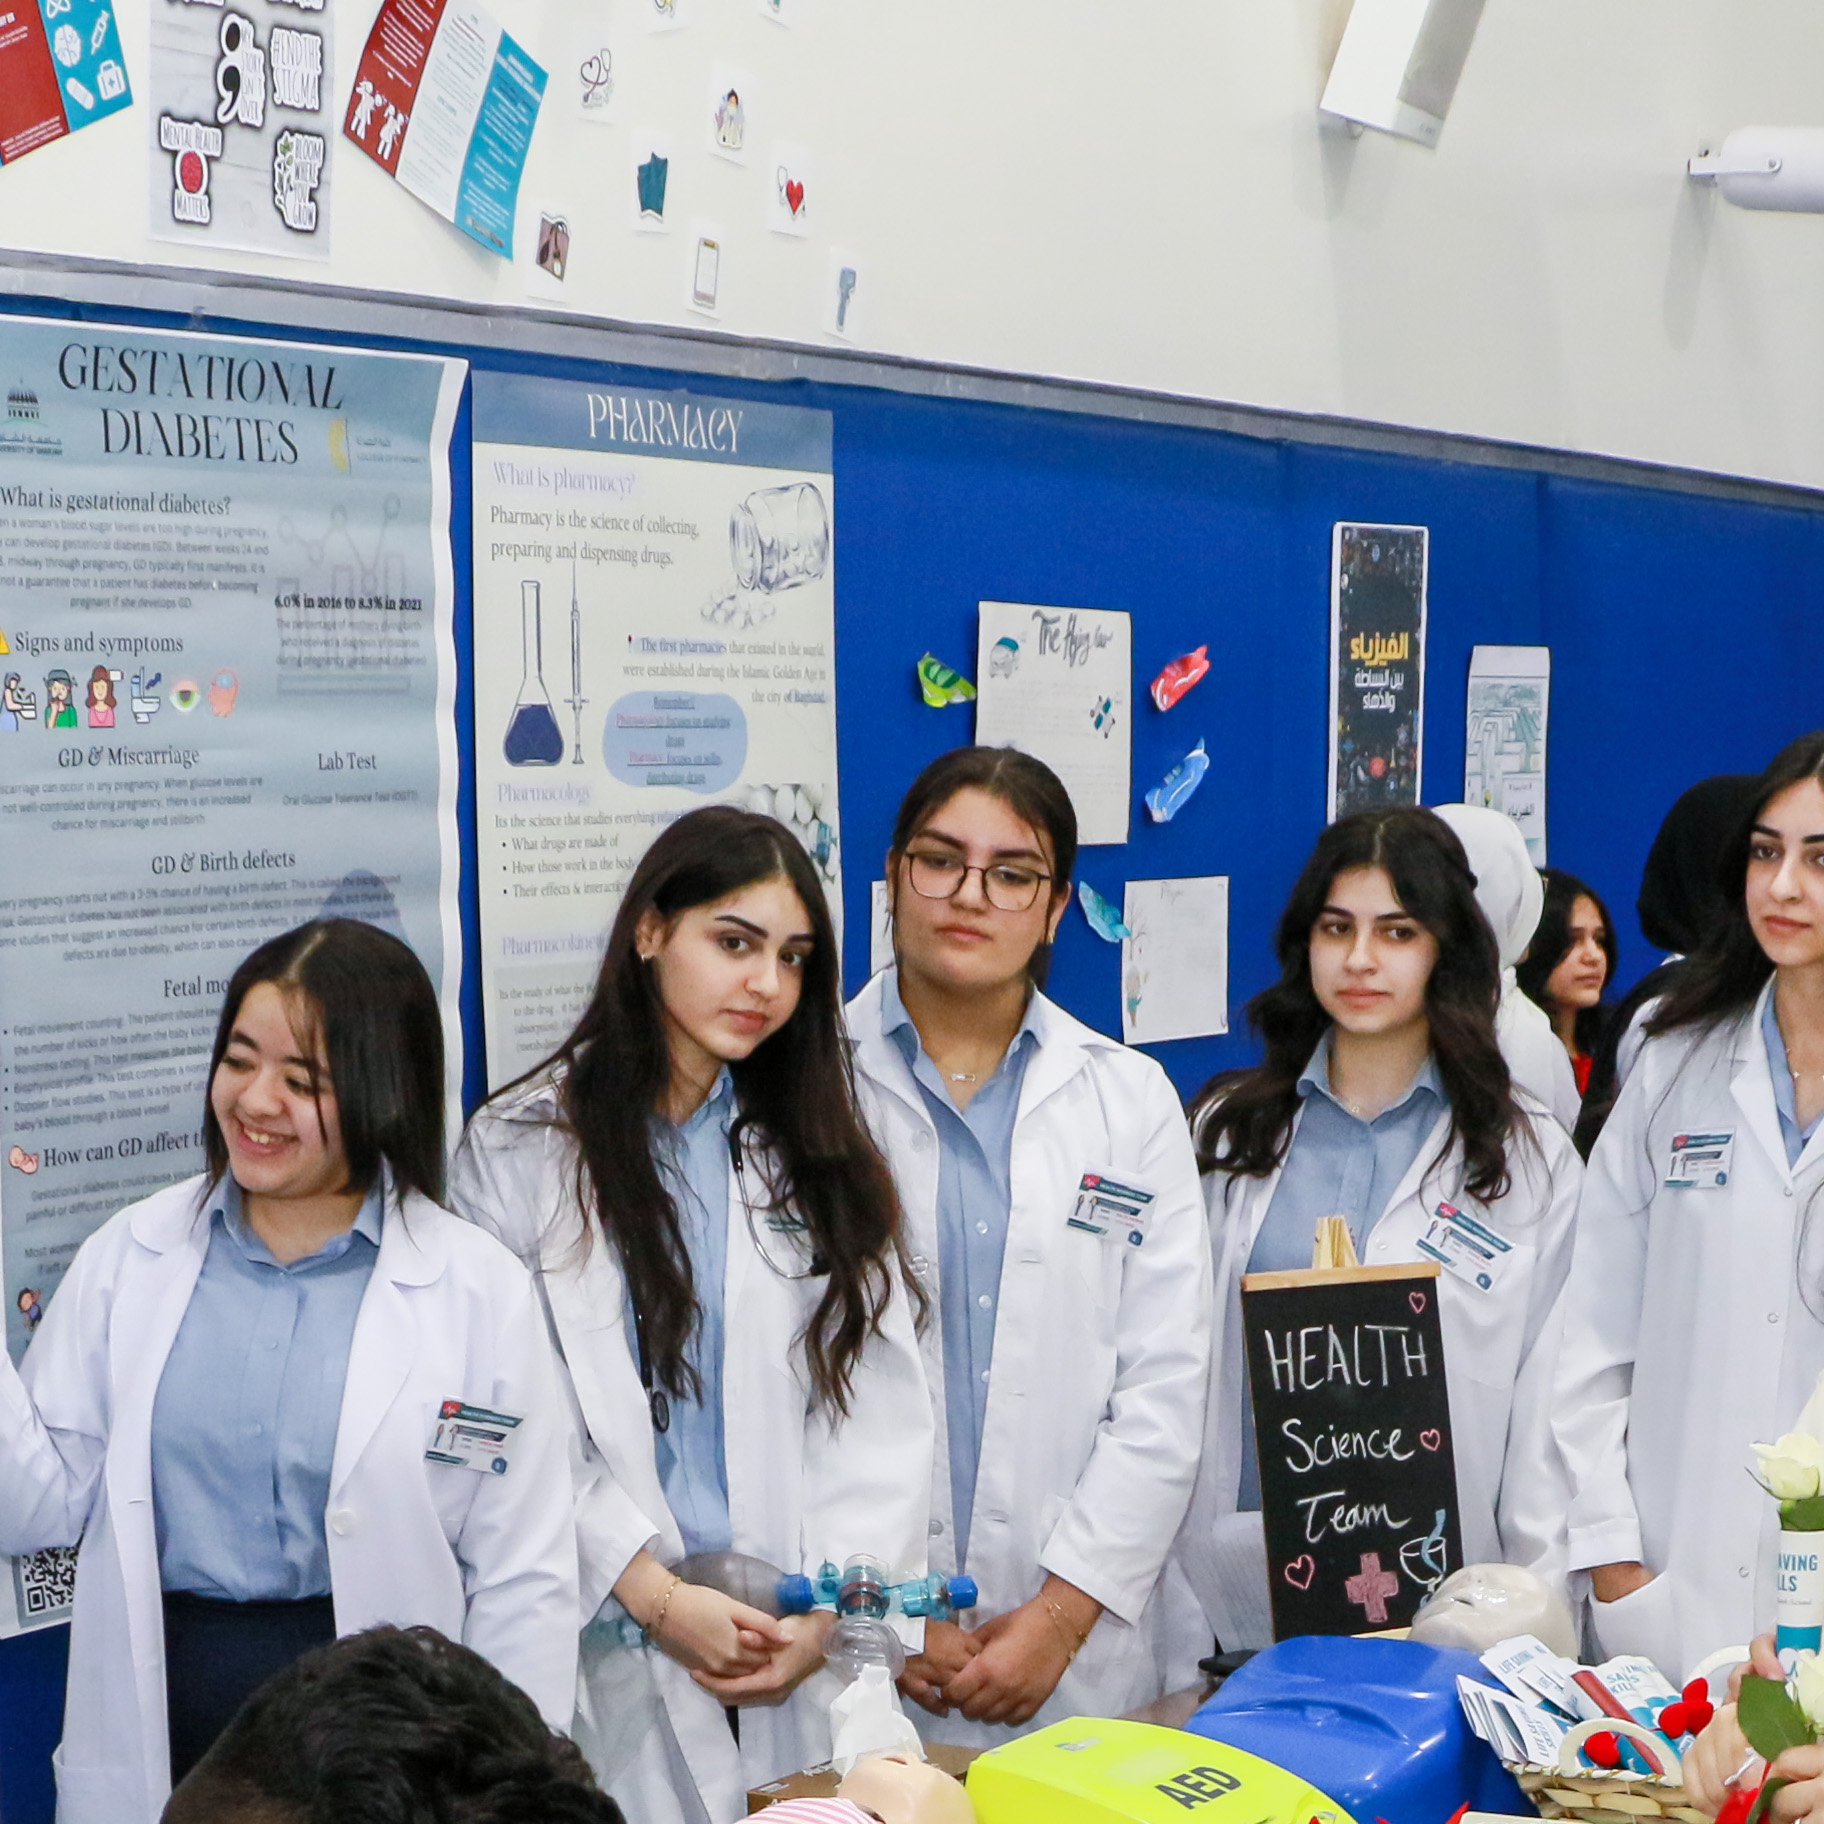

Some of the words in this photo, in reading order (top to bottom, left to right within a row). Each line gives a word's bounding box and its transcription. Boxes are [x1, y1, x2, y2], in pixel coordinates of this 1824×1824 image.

[275, 67, 319, 110] STIGMA
[58, 342, 344, 411] GESTATIONAL
[100, 407, 299, 465] DIABETES
[587, 393, 744, 453] PHARMACY
[494, 460, 533, 486] What
[537, 467, 550, 487] is
[554, 467, 636, 500] pharmacy?
[0, 486, 44, 508] What
[49, 488, 62, 508] is
[66, 490, 154, 514] gestational
[159, 493, 231, 516] diabetes?
[491, 505, 552, 531] Pharmacy
[556, 509, 566, 527] is
[568, 509, 587, 528] the
[590, 512, 630, 530] science
[633, 515, 645, 532] of
[647, 515, 699, 540] collecting,
[491, 541, 552, 562] preparing
[556, 541, 577, 560] and
[580, 542, 638, 565] dispensing
[641, 549, 674, 568] drugs.
[303, 595, 315, 609] in
[317, 596, 342, 610] 2016
[345, 596, 355, 610] to
[385, 596, 396, 610] in
[399, 598, 422, 611] 2021
[15, 631, 59, 655] Signs
[64, 632, 94, 652] and
[99, 635, 184, 656] symptoms
[1032, 609, 1061, 655] The
[641, 637, 657, 652] The
[659, 638, 677, 651] first
[680, 638, 727, 656] pharmacies
[729, 640, 746, 654] that
[1351, 632, 1409, 667] الفيزياء
[647, 664, 694, 678] established
[696, 665, 725, 681] during
[727, 665, 740, 677] the
[773, 665, 802, 679] Golden
[58, 748, 83, 768] GD
[88, 746, 104, 767] &
[108, 745, 200, 769] Miscarriage
[318, 751, 343, 770] Lab
[346, 752, 377, 770] Test
[497, 782, 591, 806] Pharmacology
[495, 815, 509, 828] Its
[510, 814, 526, 827] the
[529, 814, 562, 827] science
[564, 812, 582, 826] that
[584, 811, 613, 825] studies
[512, 838, 538, 851] What
[541, 836, 567, 853] drugs
[568, 839, 582, 849] are
[585, 835, 608, 848] made
[610, 833, 619, 847] of
[152, 855, 175, 875] GD
[180, 852, 196, 873] &
[200, 850, 238, 872] Birth
[242, 849, 296, 870] defects
[512, 861, 534, 875] How
[538, 860, 562, 873] those
[564, 858, 588, 872] work
[589, 858, 598, 871] in
[600, 857, 613, 870] the
[513, 884, 538, 898] Their
[541, 882, 570, 897] effects
[163, 975, 201, 998] Fetal
[43, 1149, 80, 1167] How
[86, 1146, 114, 1161] can
[118, 1137, 142, 1157] GD
[146, 1131, 189, 1154] affect
[1264, 1323, 1428, 1393] HEALTH
[1281, 1418, 1416, 1473] Science
[1295, 1490, 1412, 1544] Team
[1154, 1766, 1242, 1810] AED
